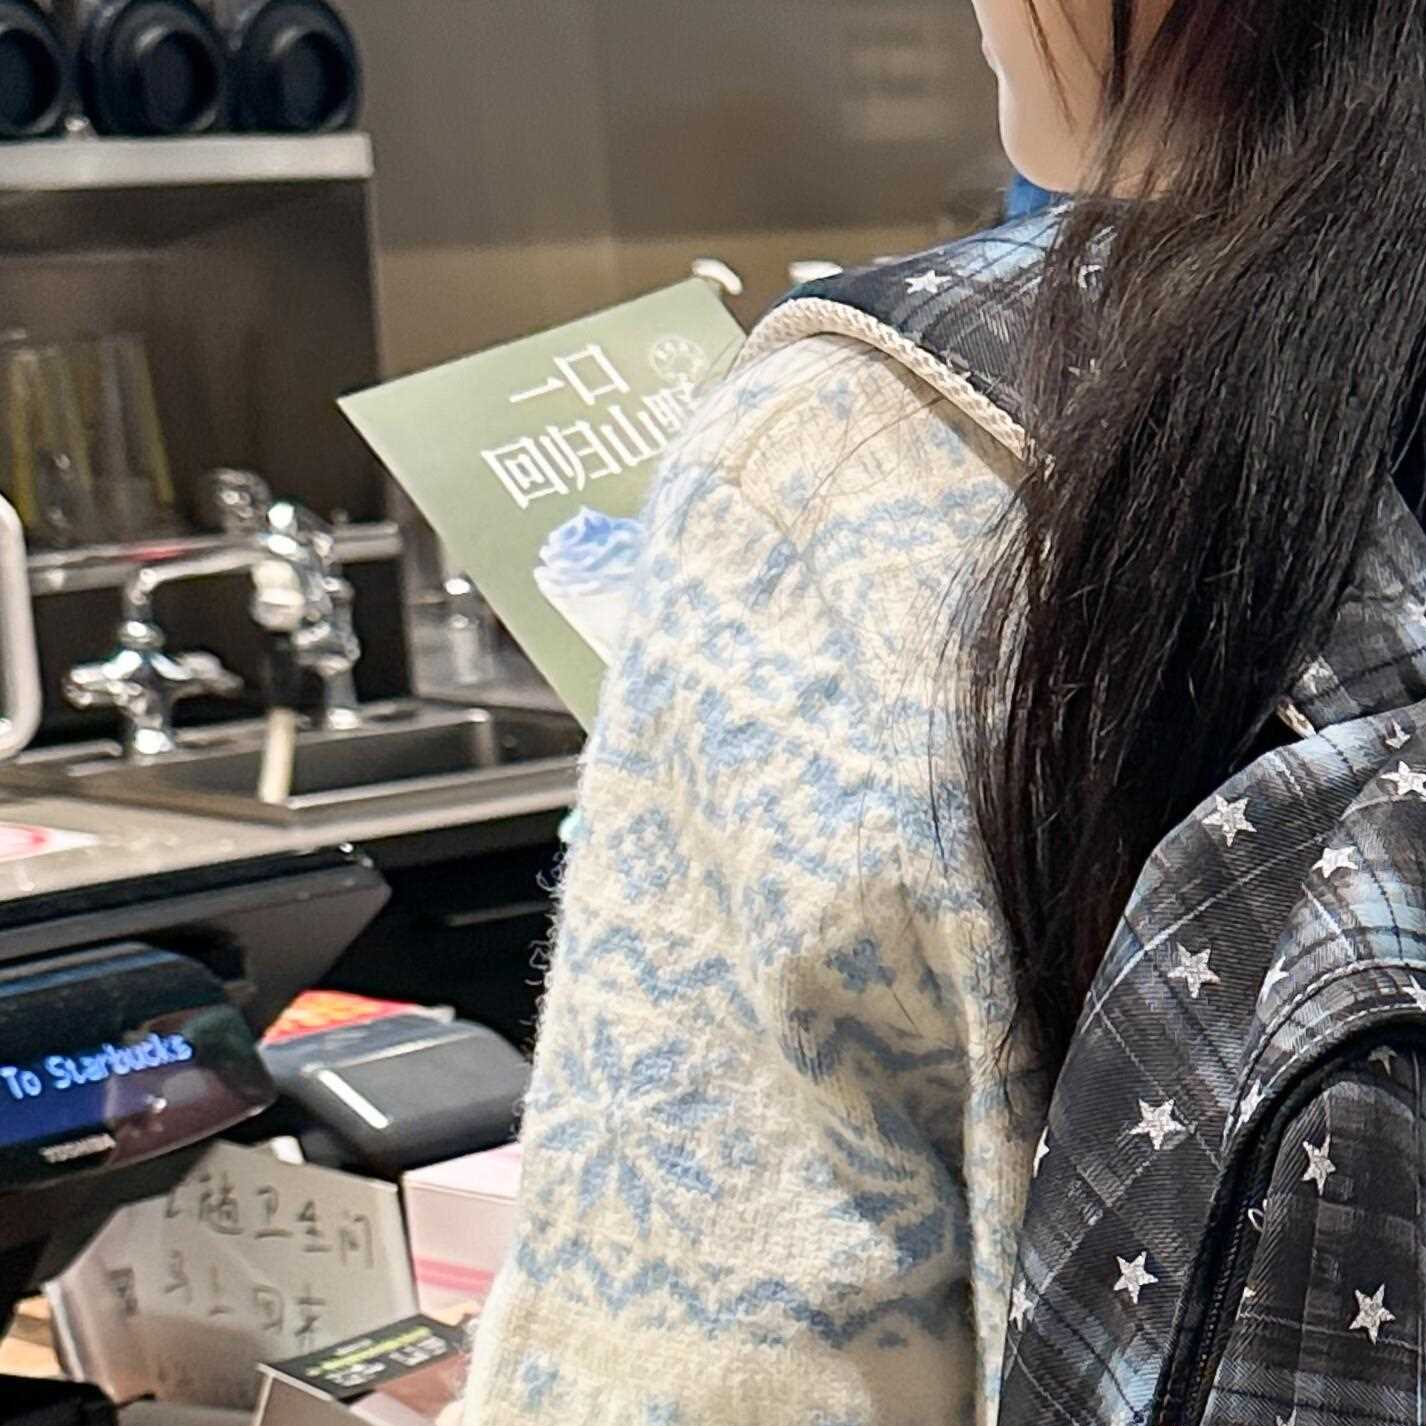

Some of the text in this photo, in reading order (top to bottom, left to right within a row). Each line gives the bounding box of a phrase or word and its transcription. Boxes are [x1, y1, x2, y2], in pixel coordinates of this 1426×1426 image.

[509, 343, 631, 406] 一口
[0, 1033, 193, 1100] To Starbucks
